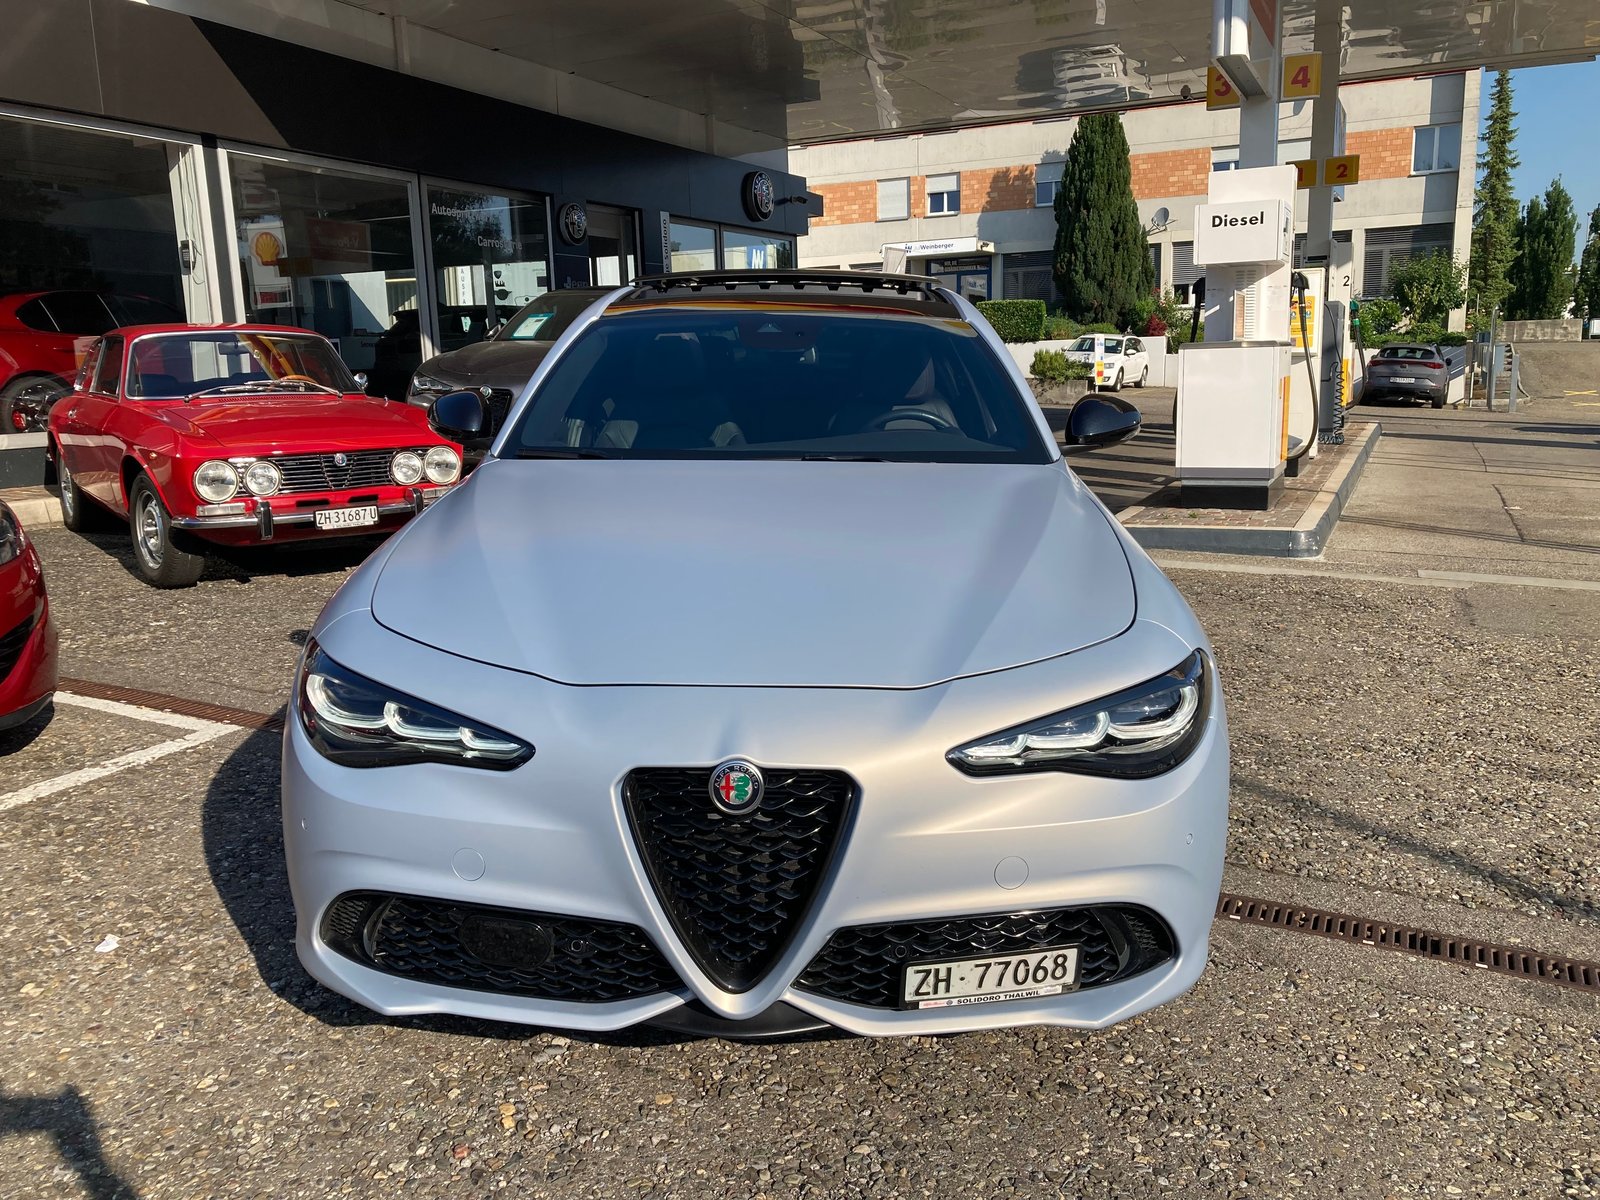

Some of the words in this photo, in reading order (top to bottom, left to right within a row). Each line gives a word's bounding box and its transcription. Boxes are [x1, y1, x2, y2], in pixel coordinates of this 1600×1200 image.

[1214, 74, 1232, 97] 3
[1291, 65, 1311, 88] 4
[1336, 163, 1348, 179] 2
[1211, 211, 1264, 228] Diesel
[1343, 275, 1350, 287] 2
[317, 512, 331, 525] ZH
[334, 508, 367, 523] 31687
[369, 507, 377, 520] U
[714, 768, 730, 788] ALFA
[733, 765, 759, 789] ROMEO
[913, 966, 952, 997] ZH
[974, 953, 1069, 989] 77068
[956, 994, 1001, 1005] SOLIDORO
[1003, 990, 1041, 1000] THALWIL
